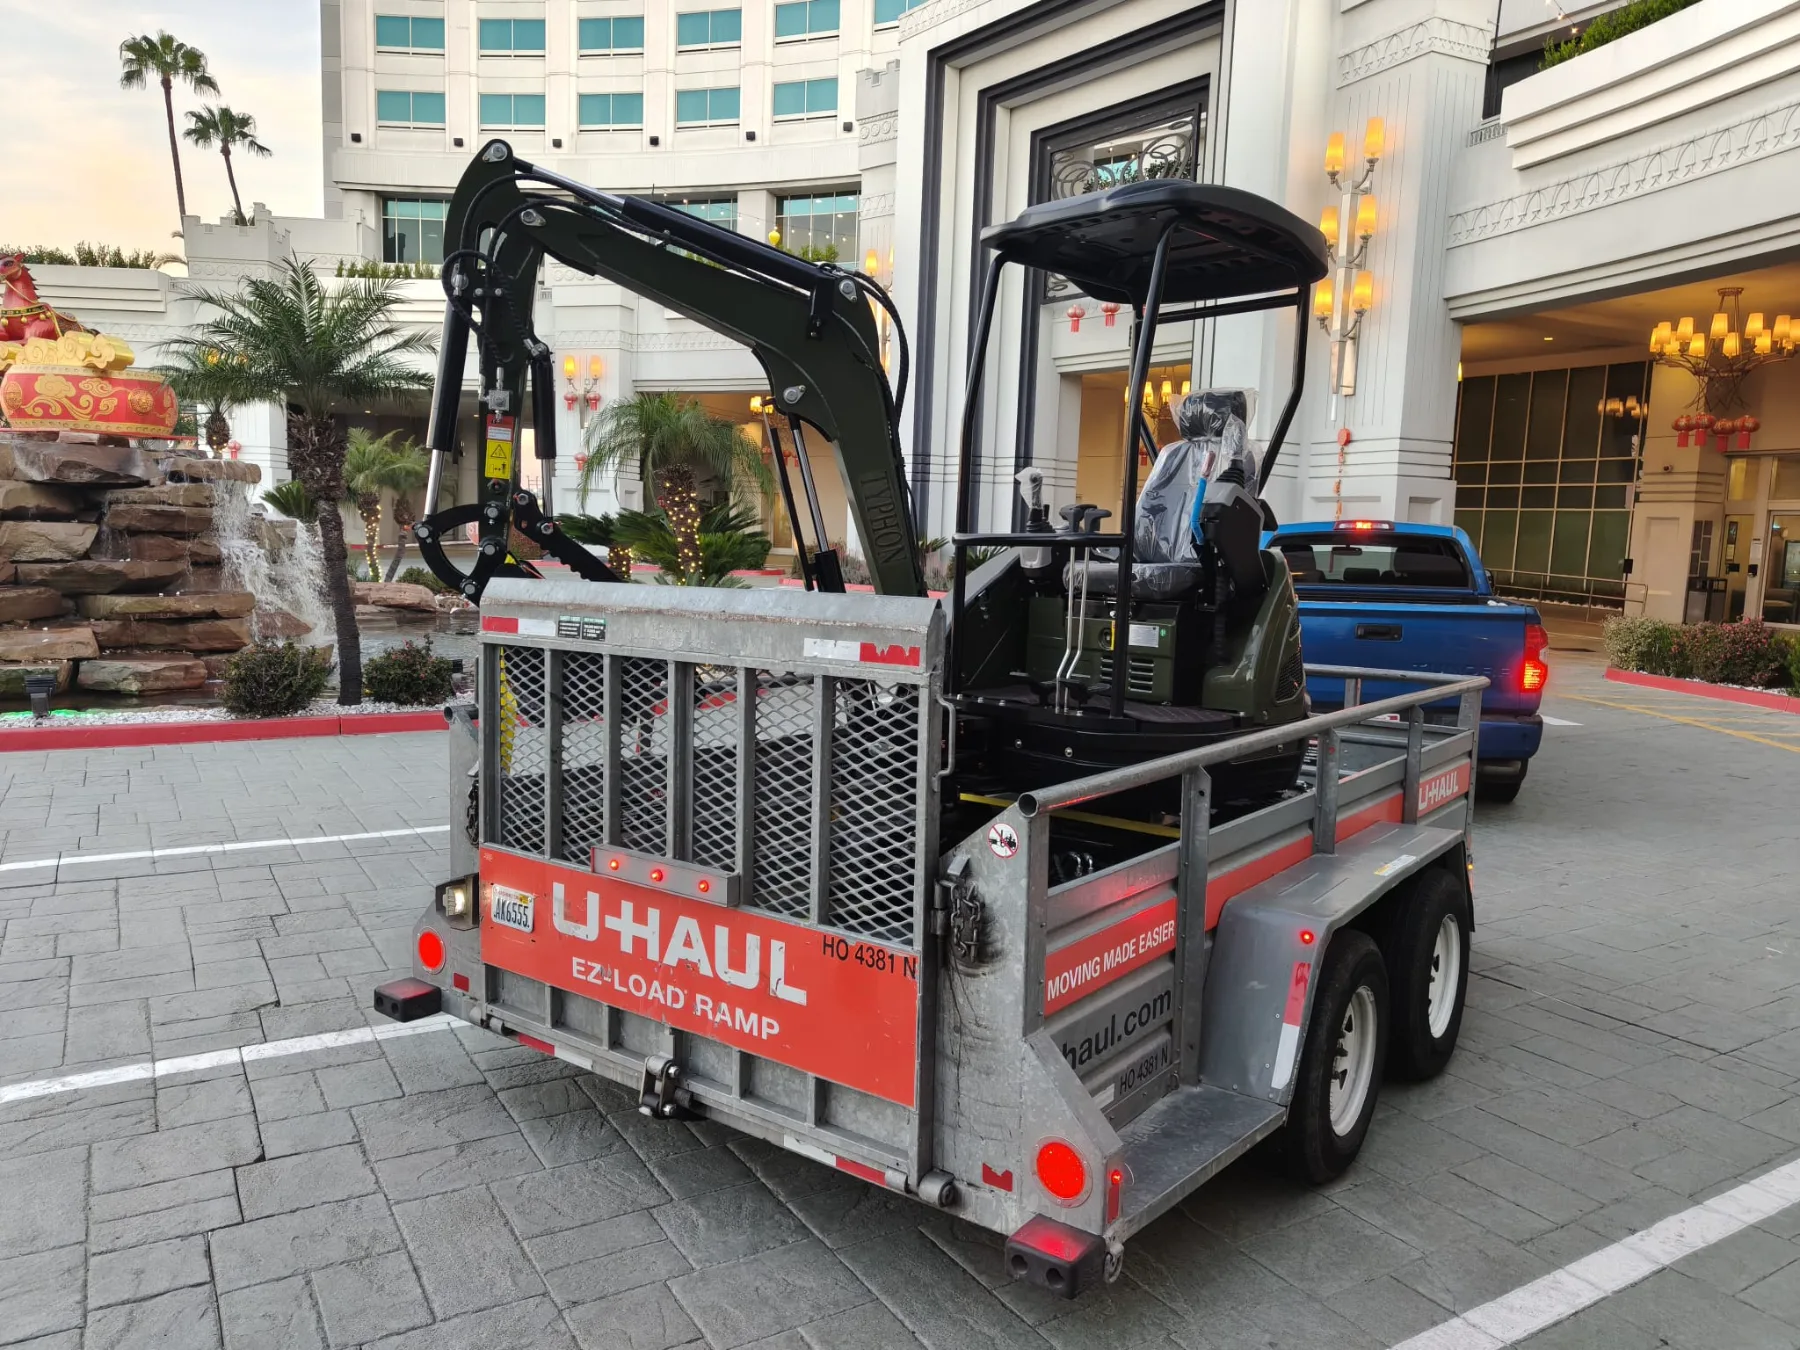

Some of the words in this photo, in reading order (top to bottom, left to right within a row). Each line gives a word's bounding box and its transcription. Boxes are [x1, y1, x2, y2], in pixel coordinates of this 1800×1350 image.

[860, 471, 908, 565] TYPHON
[1418, 771, 1459, 811] U-HAUL
[552, 881, 807, 1007] U-HAUL
[823, 934, 849, 961] HO
[855, 945, 895, 974] 4381
[903, 956, 917, 979] N
[1047, 956, 1100, 1002] MOVING
[1103, 938, 1136, 973] MADE
[1138, 919, 1175, 954] EASIER
[572, 956, 686, 1010] EZ-LOAD
[693, 992, 780, 1040] RAMP
[1119, 1068, 1136, 1095] HO
[1137, 1056, 1158, 1080] 4381
[1160, 1047, 1169, 1066] N
